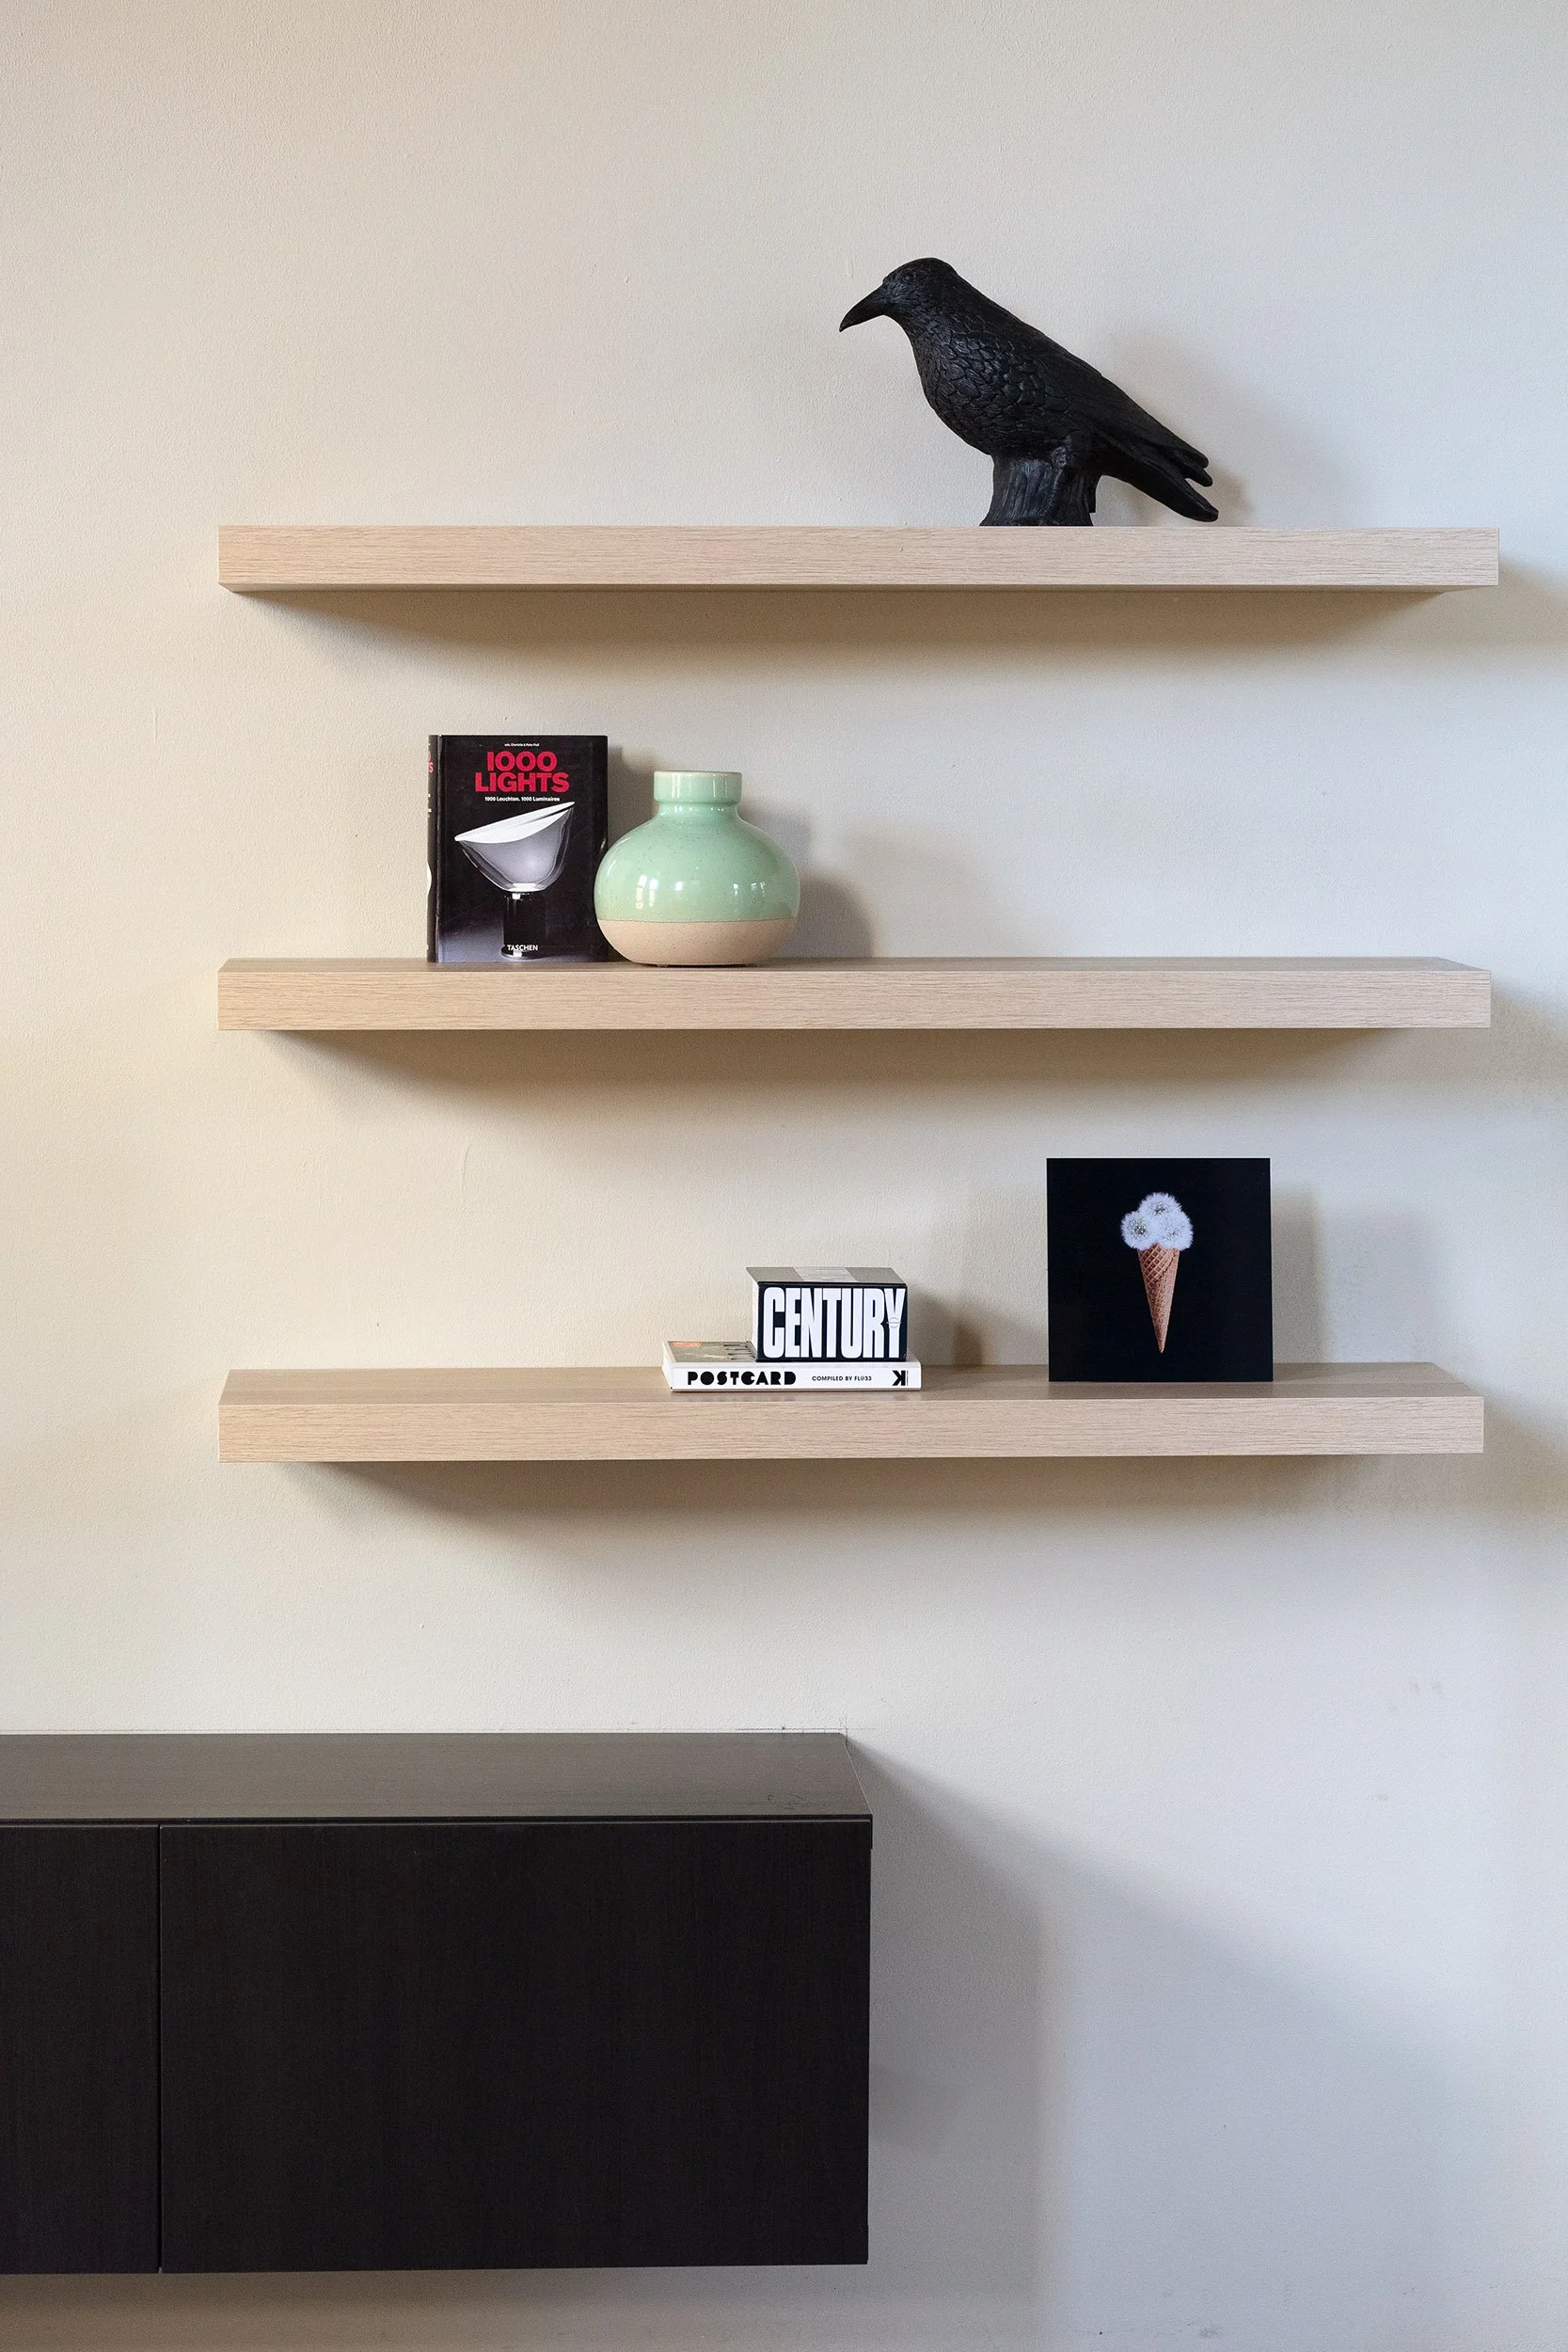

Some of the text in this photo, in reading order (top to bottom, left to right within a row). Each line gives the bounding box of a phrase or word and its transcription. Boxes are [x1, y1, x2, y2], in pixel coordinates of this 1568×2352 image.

[486, 751, 558, 771] 1000
[475, 771, 570, 793] LIGHTS
[762, 1286, 905, 1359] CENTURY
[687, 1371, 798, 1386] POSTCARD
